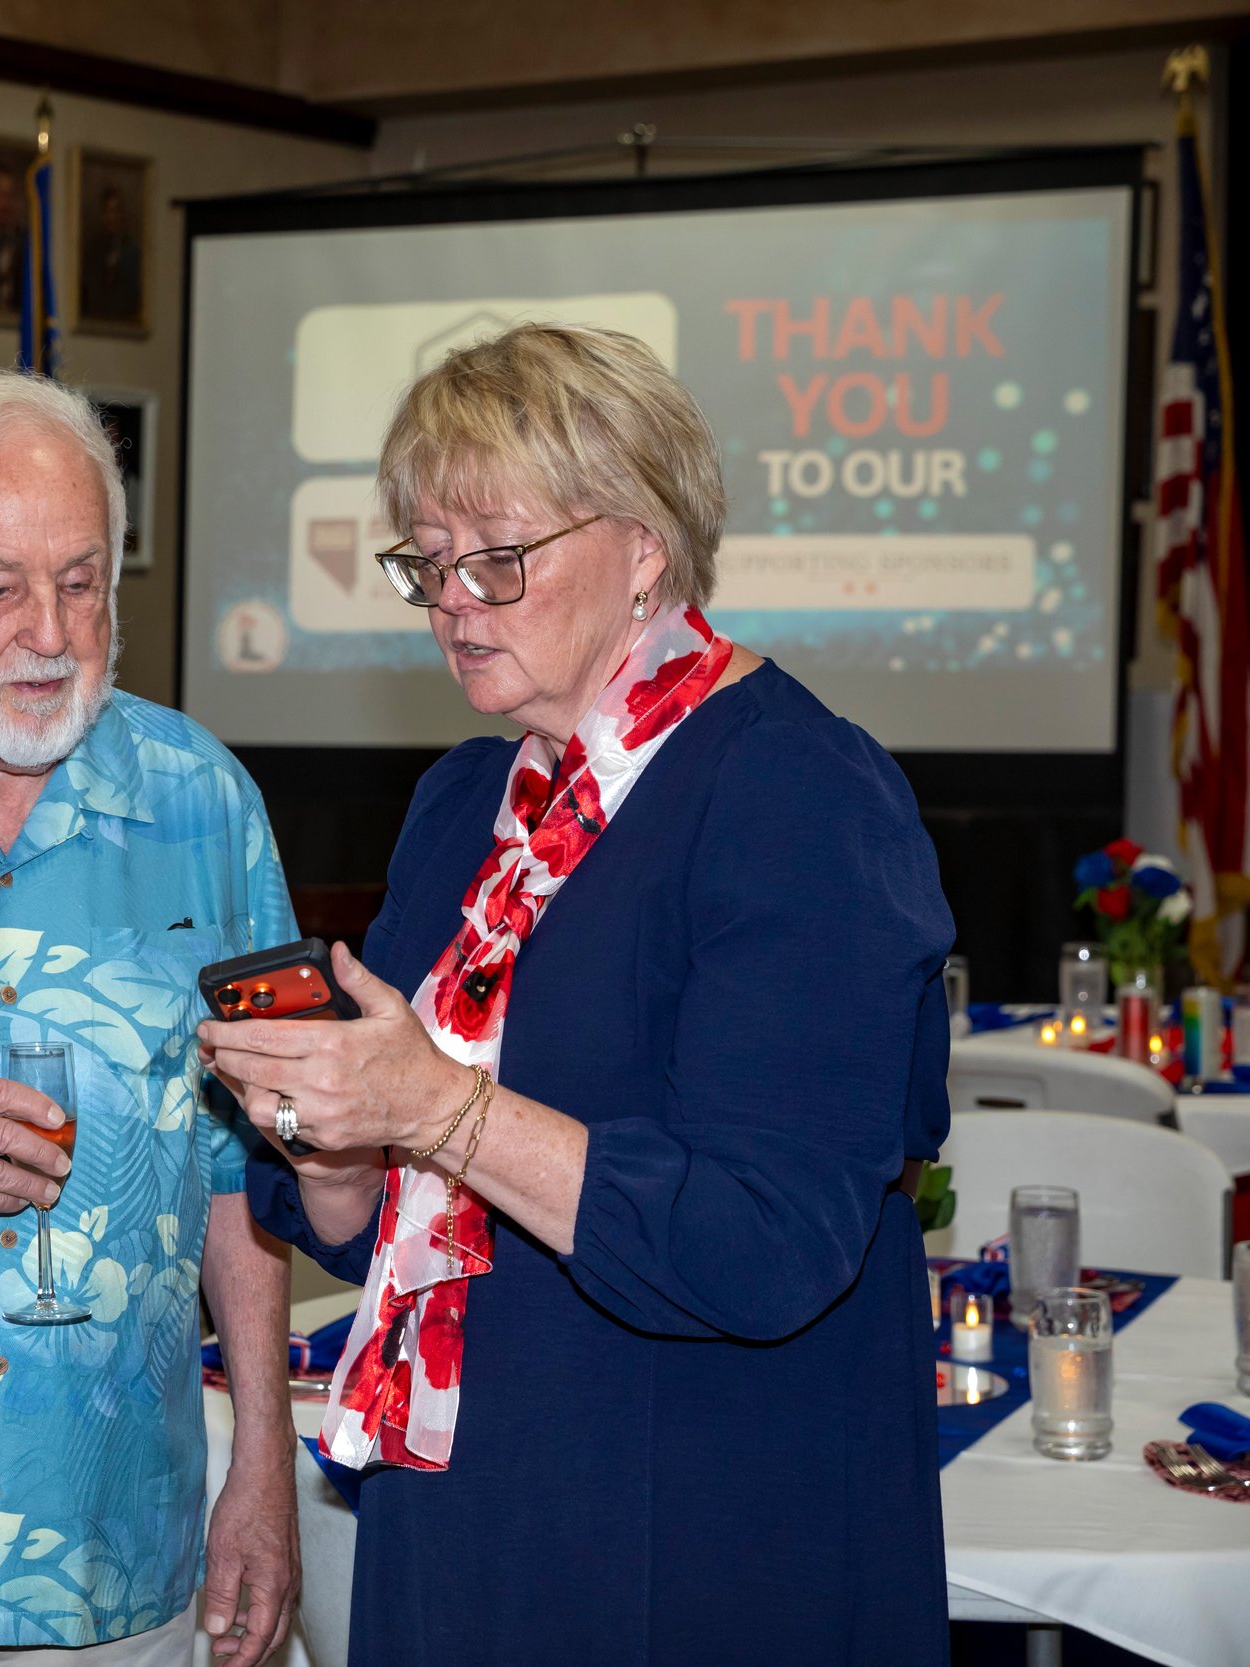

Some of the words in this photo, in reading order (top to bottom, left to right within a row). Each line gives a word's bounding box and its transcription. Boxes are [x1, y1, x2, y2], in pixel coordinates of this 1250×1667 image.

[724, 294, 1006, 361] THANK
[777, 372, 949, 438] YOU
[757, 449, 834, 498] TO
[840, 449, 968, 498] OUR
[717, 551, 873, 577] UPPORTING
